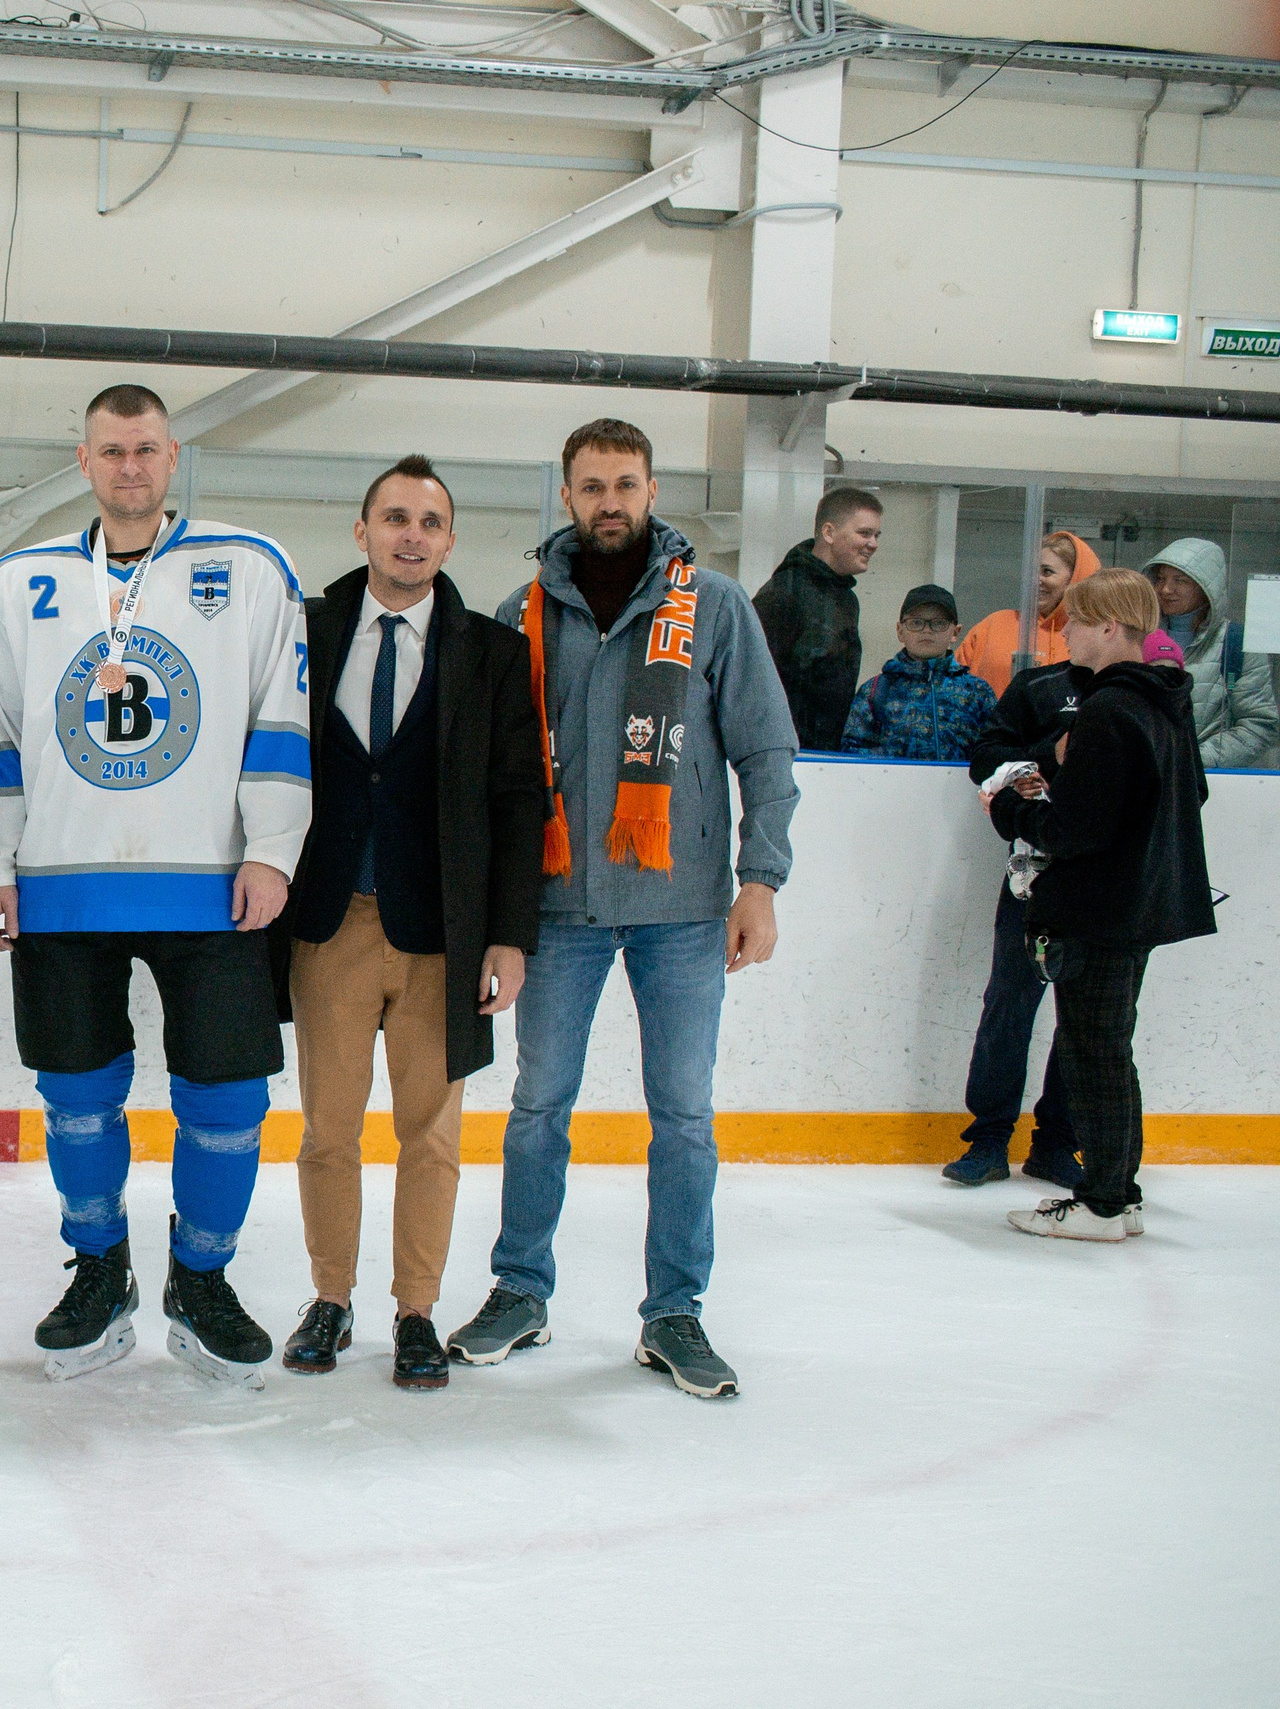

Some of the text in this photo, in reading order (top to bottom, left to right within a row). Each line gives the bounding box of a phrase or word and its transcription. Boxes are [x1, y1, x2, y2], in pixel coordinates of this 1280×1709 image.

[1115, 312, 1166, 330] ВЫХОД
[1126, 326, 1150, 337] EXIT
[1211, 335, 1280, 355] ВЫХОД
[28, 575, 60, 620] 2
[70, 634, 185, 686] ХК ВМПЕЛ
[103, 671, 155, 744] В
[101, 760, 148, 781] 2014
